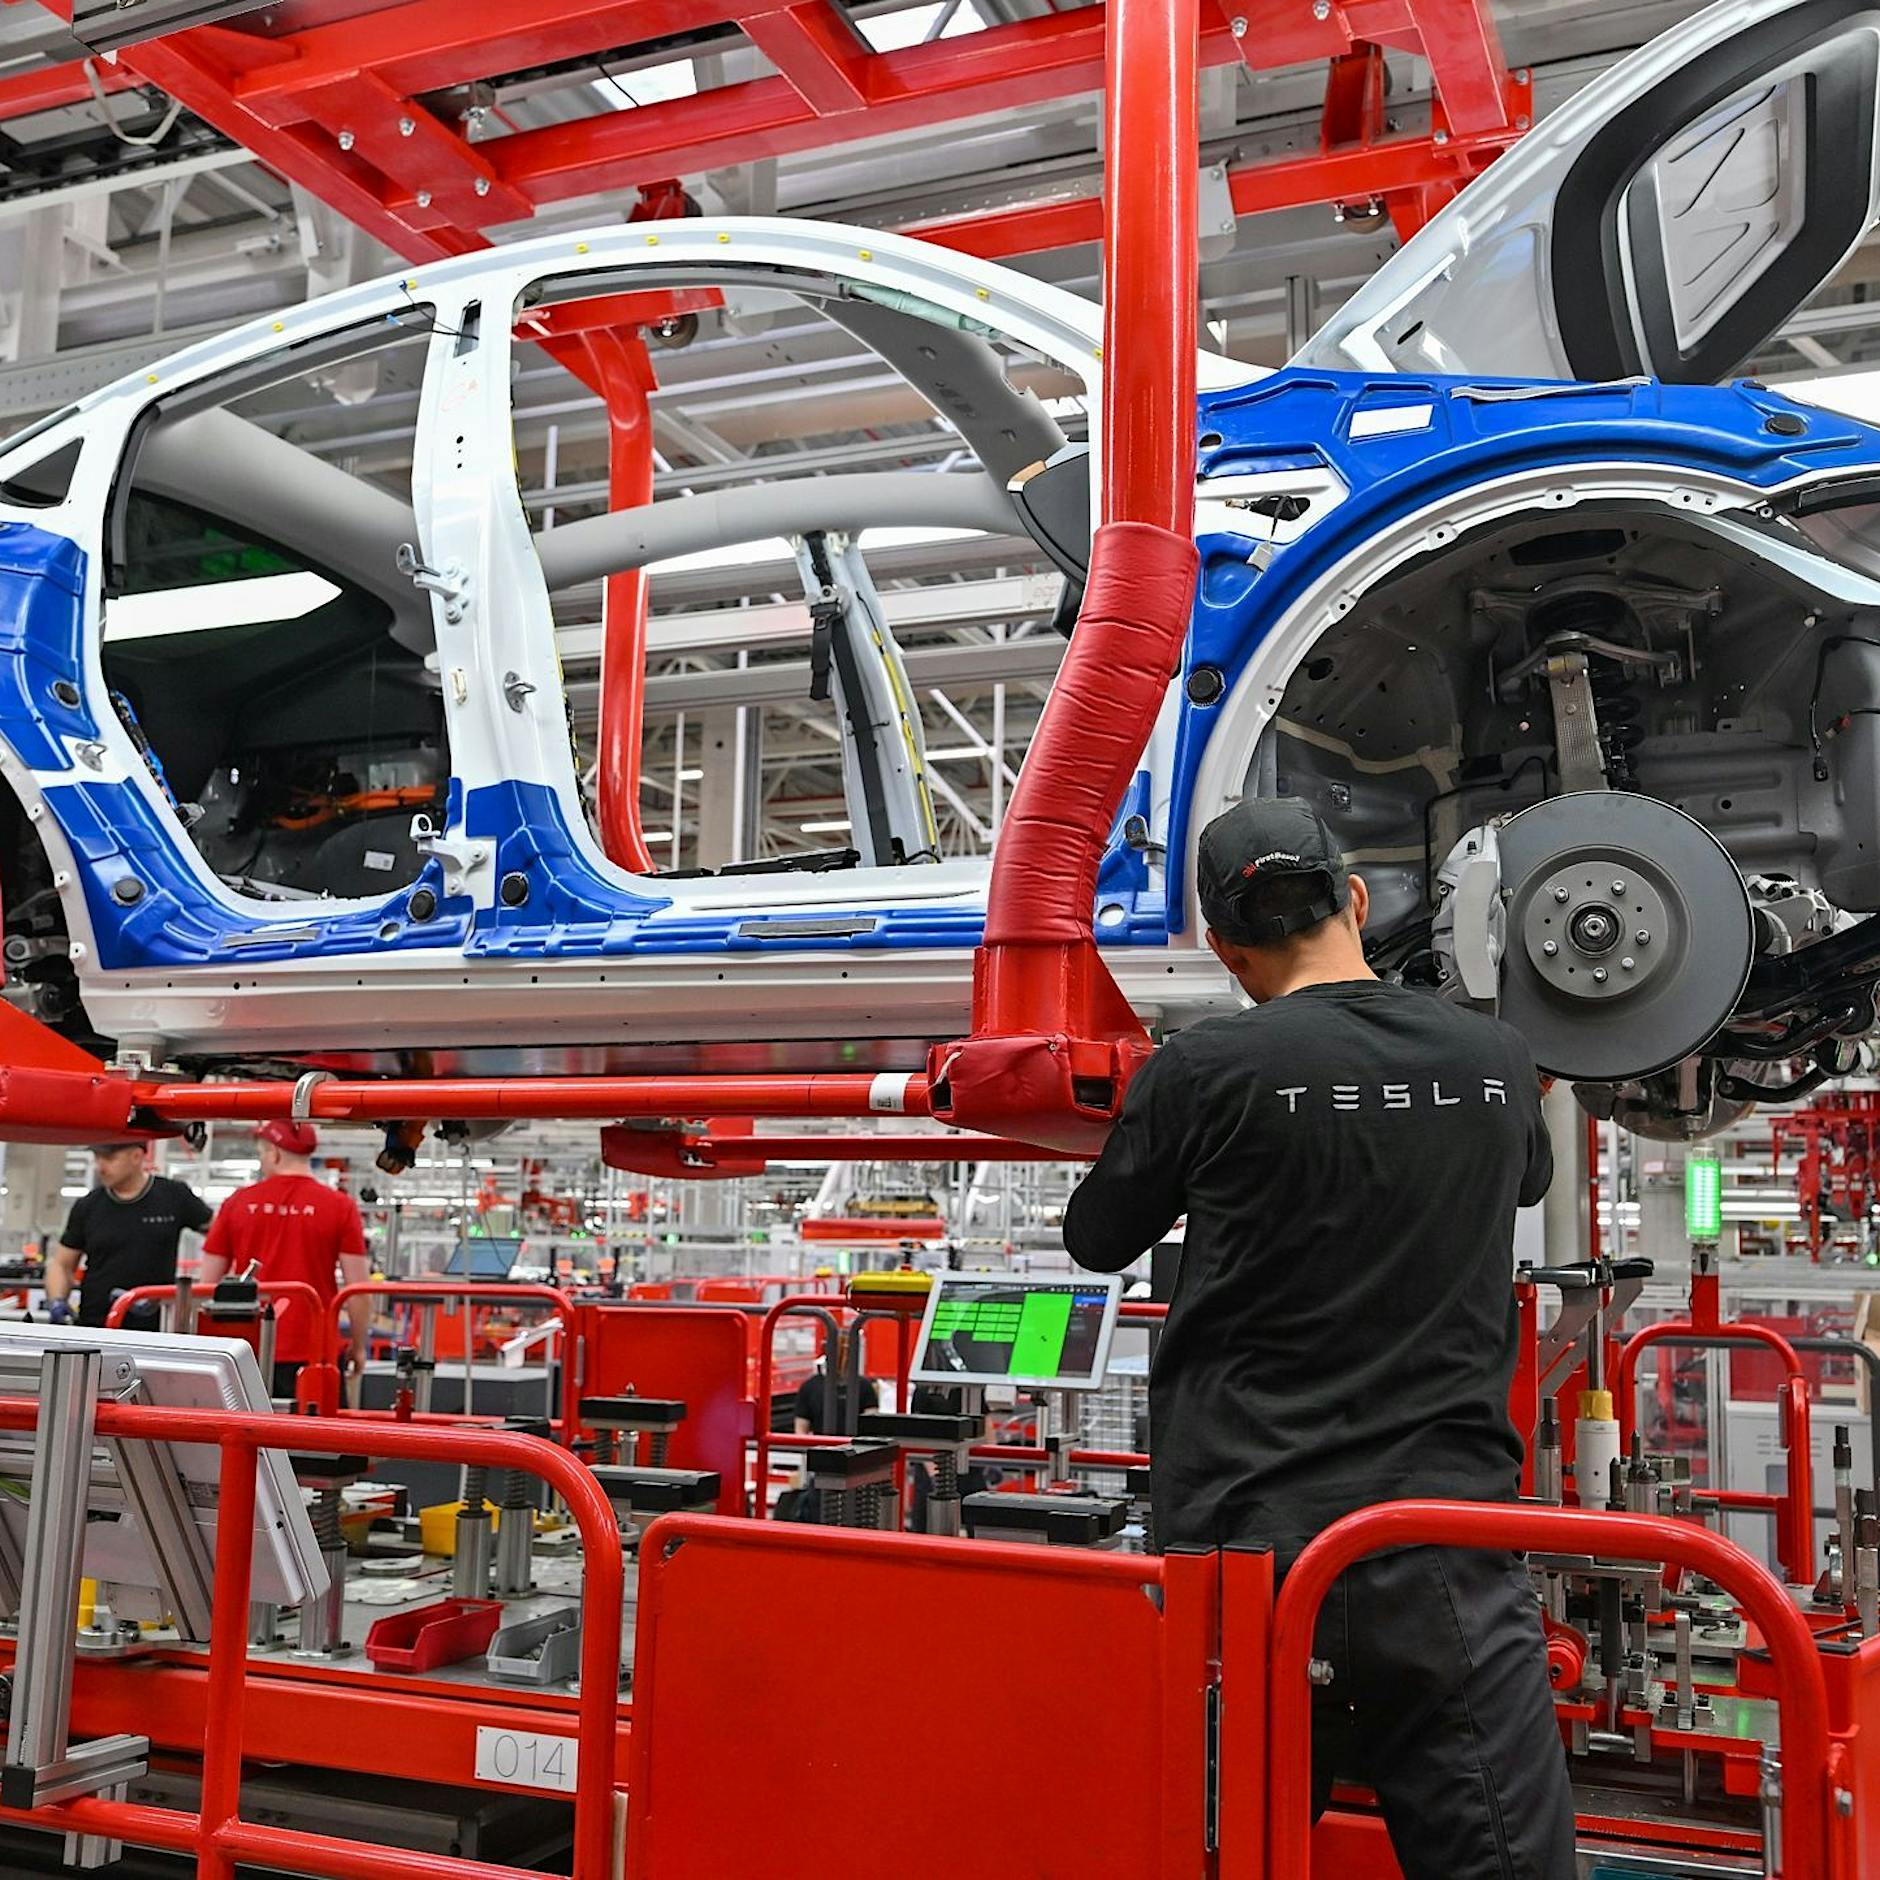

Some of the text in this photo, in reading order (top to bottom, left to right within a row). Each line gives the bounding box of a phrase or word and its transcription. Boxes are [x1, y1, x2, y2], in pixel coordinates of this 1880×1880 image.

[1275, 1078, 1507, 1114] TESLA
[247, 1203, 315, 1216] TESLA
[494, 1734, 566, 1785] 014
